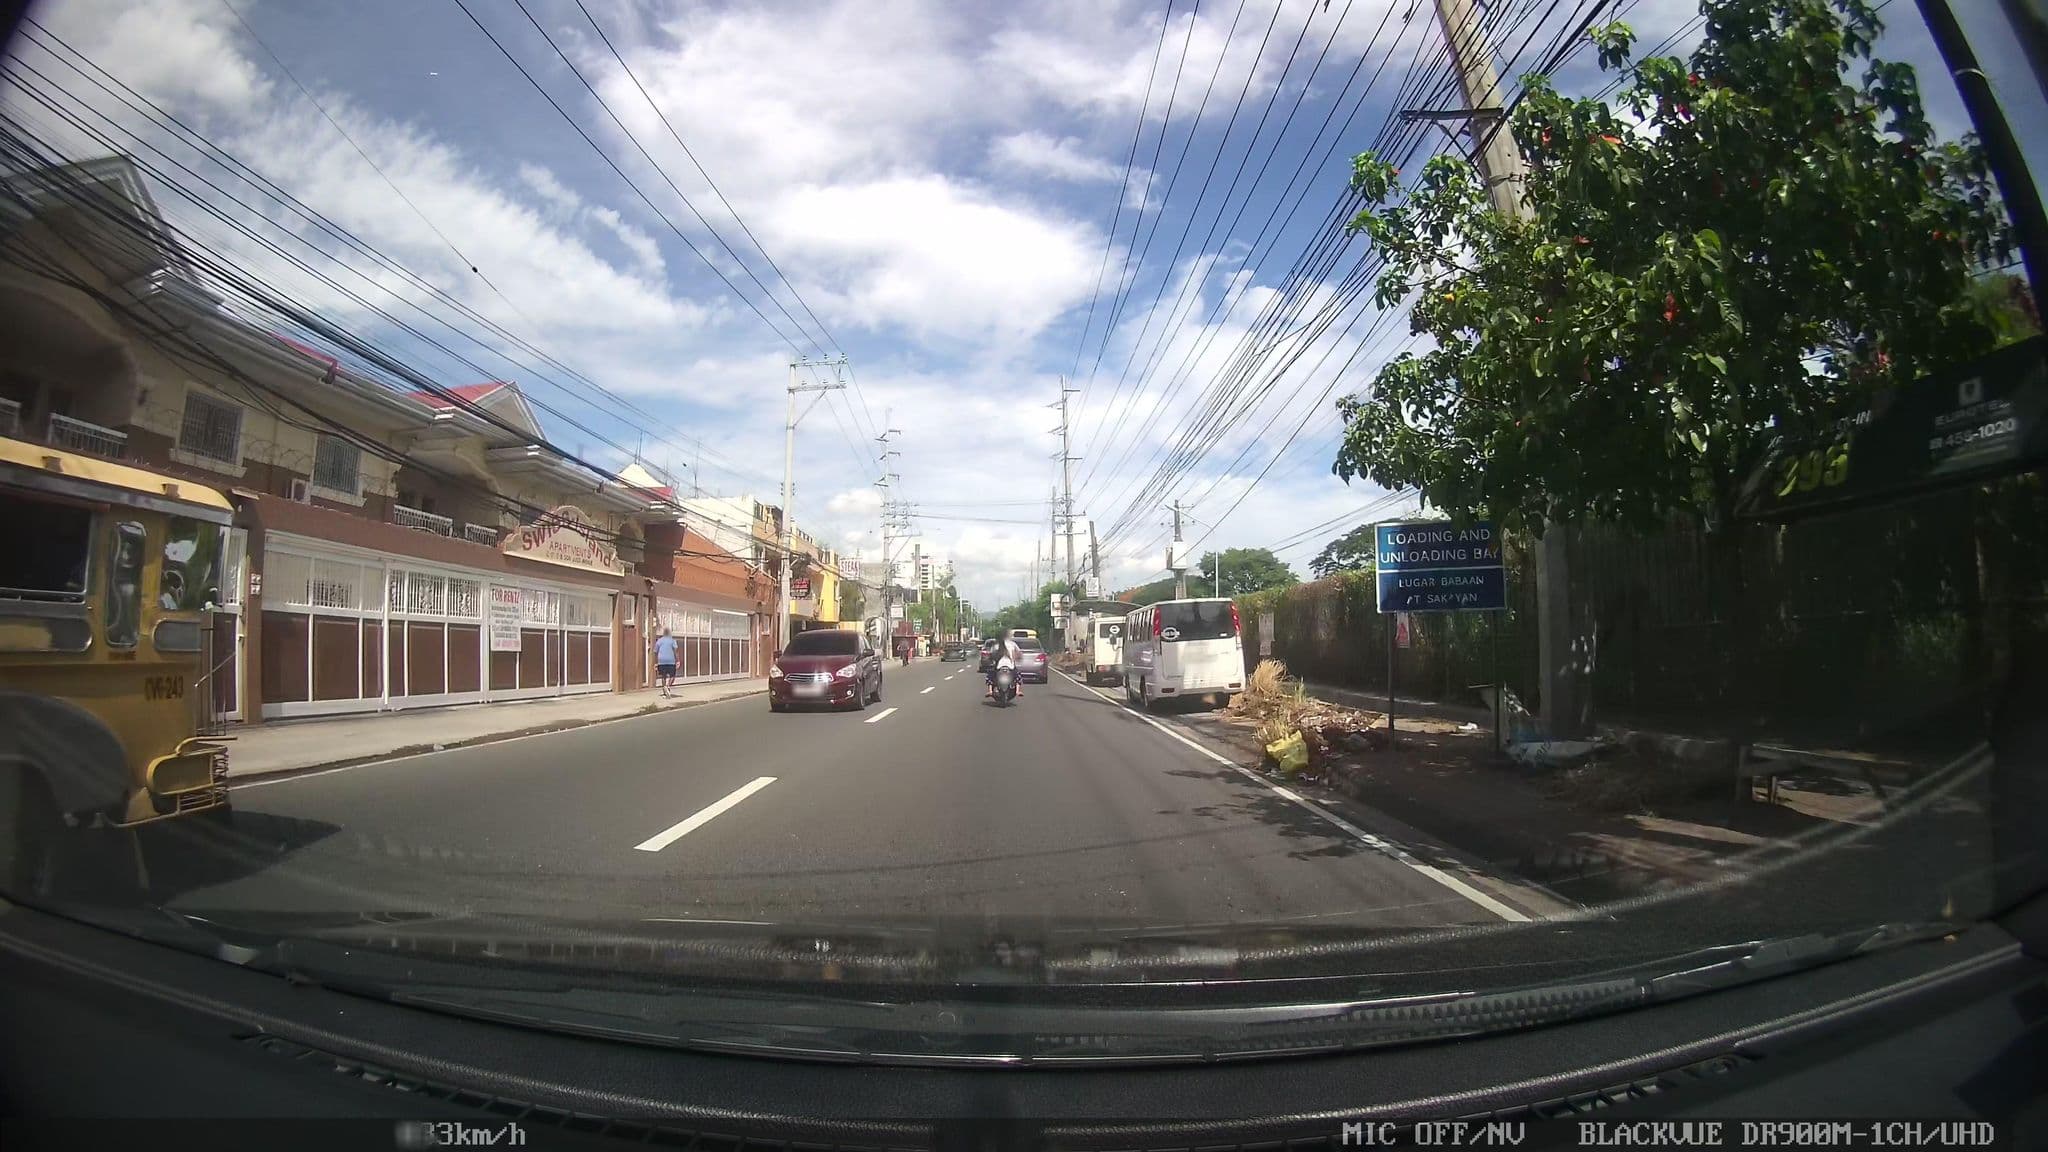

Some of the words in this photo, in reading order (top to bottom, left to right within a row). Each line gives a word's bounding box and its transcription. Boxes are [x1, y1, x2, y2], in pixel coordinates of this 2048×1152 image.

[1387, 530, 1453, 545] LOADING
[1459, 528, 1491, 541] AND
[1380, 549, 1467, 563] UNLOADING
[1473, 547, 1498, 560] BAY
[1398, 577, 1436, 588] LUGAR
[1441, 575, 1485, 586] BABAAN
[491, 588, 503, 602] FOR
